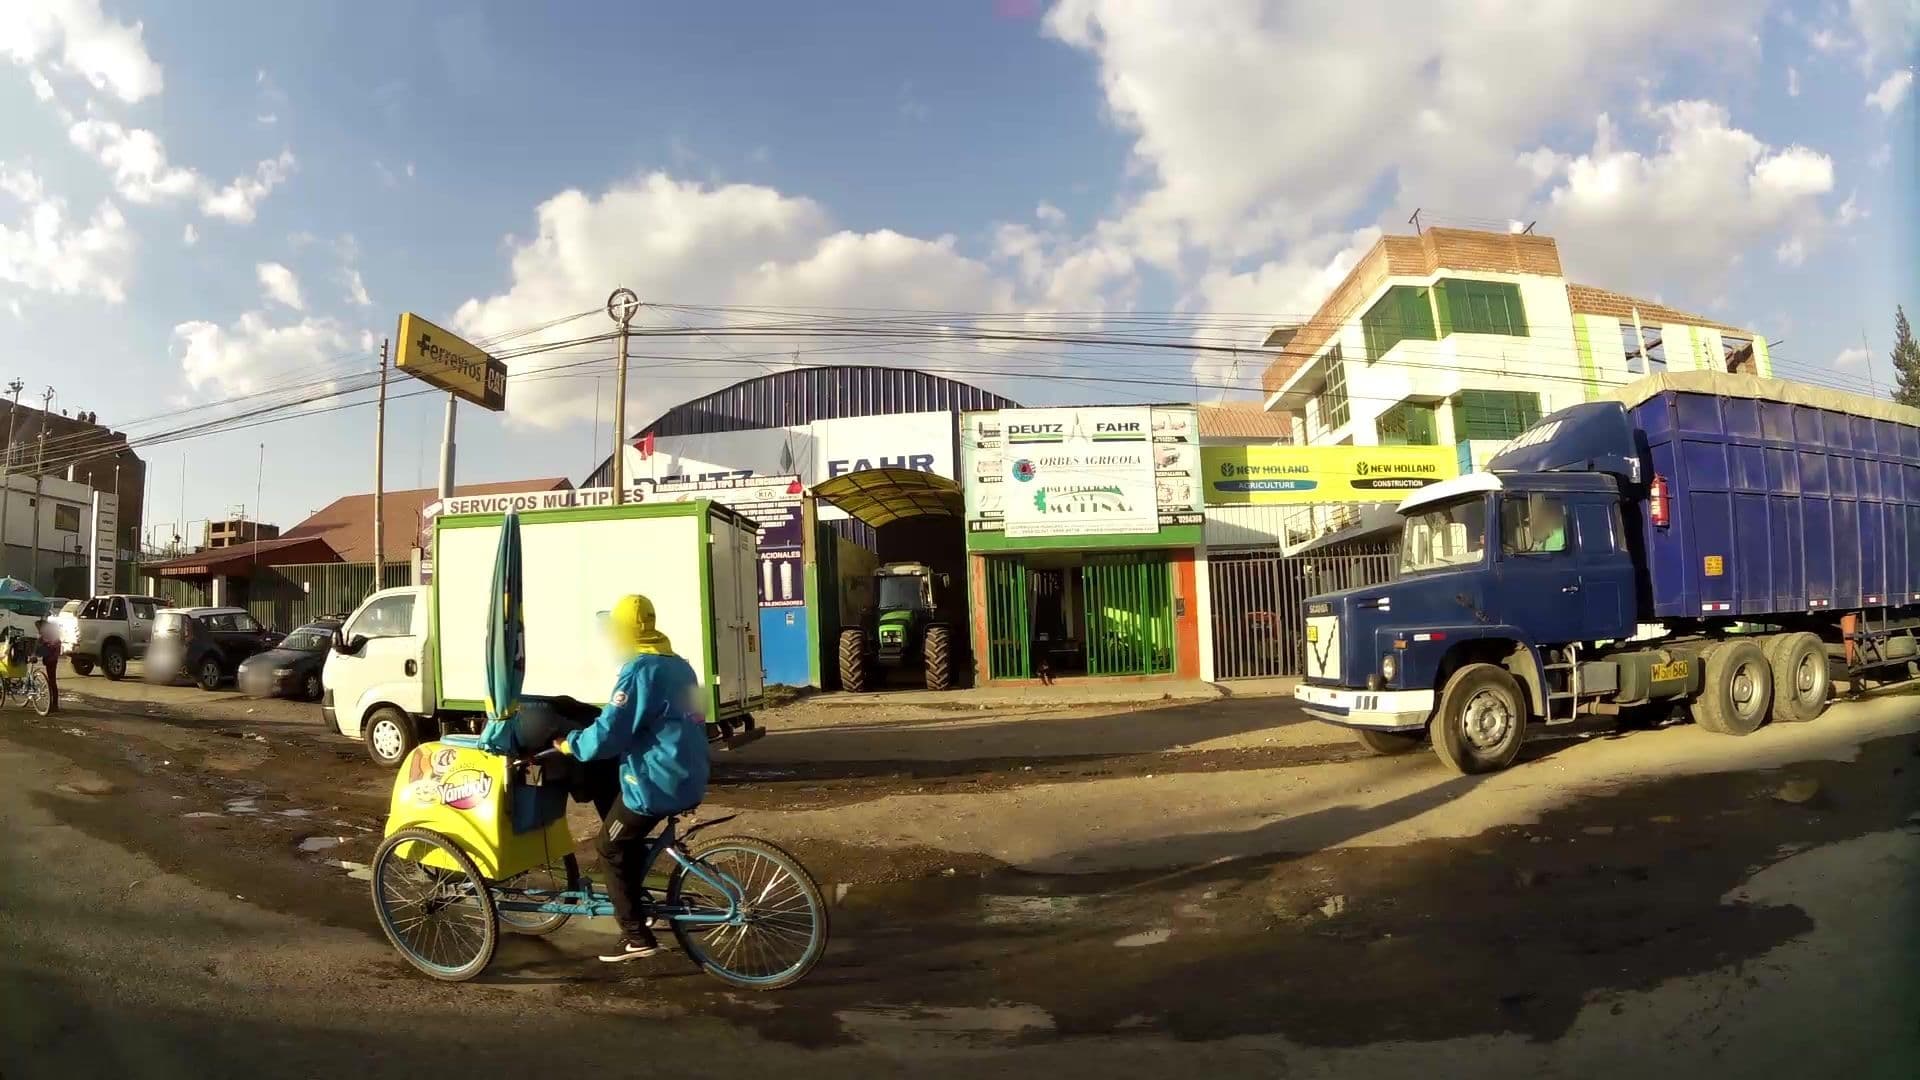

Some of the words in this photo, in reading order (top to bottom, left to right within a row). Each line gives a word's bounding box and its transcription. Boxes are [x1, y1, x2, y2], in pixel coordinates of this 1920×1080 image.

[487, 368, 505, 397] CAT
[1008, 423, 1063, 434] DEUTZ
[1096, 422, 1141, 432] FAHR
[1236, 465, 1259, 475] NEW
[1262, 464, 1310, 474] HOLLAND
[1370, 465, 1389, 474] NEW
[1393, 463, 1436, 473] HOLLAND
[1238, 481, 1296, 490] AGRICULTURE
[1372, 479, 1424, 488] CONSTRUCTION
[543, 488, 644, 508] MULTIPES
[760, 551, 800, 560] ACIONALES
